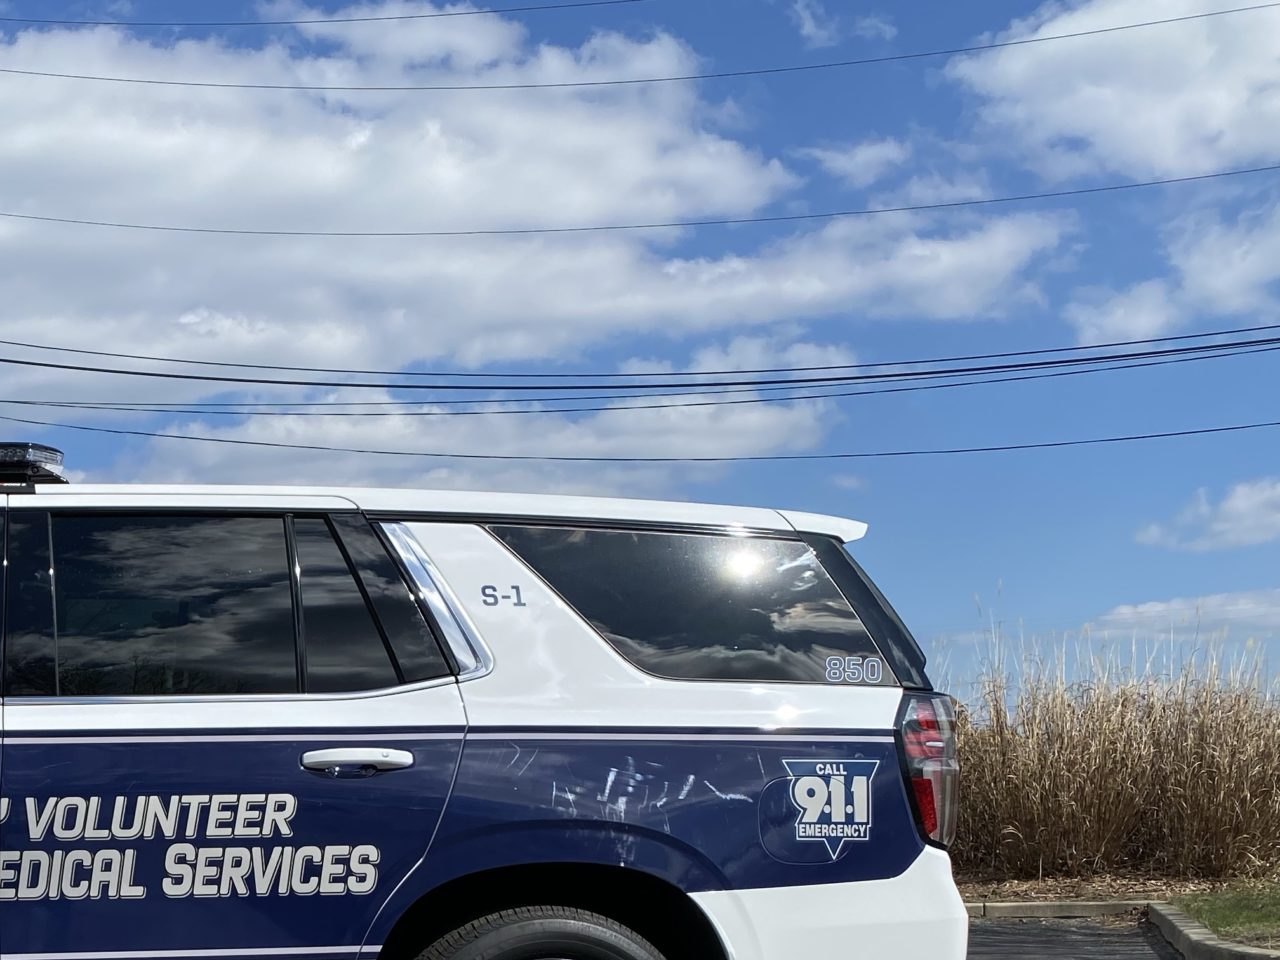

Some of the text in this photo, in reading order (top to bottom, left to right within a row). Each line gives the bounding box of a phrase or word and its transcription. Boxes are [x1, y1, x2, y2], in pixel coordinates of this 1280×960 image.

[481, 585, 526, 606] S-1
[826, 656, 883, 683] 850
[816, 764, 847, 775] CALL
[25, 793, 297, 841] VOLUNTEER
[798, 824, 867, 837] EMERGENCY
[162, 842, 380, 899] SERVICES
